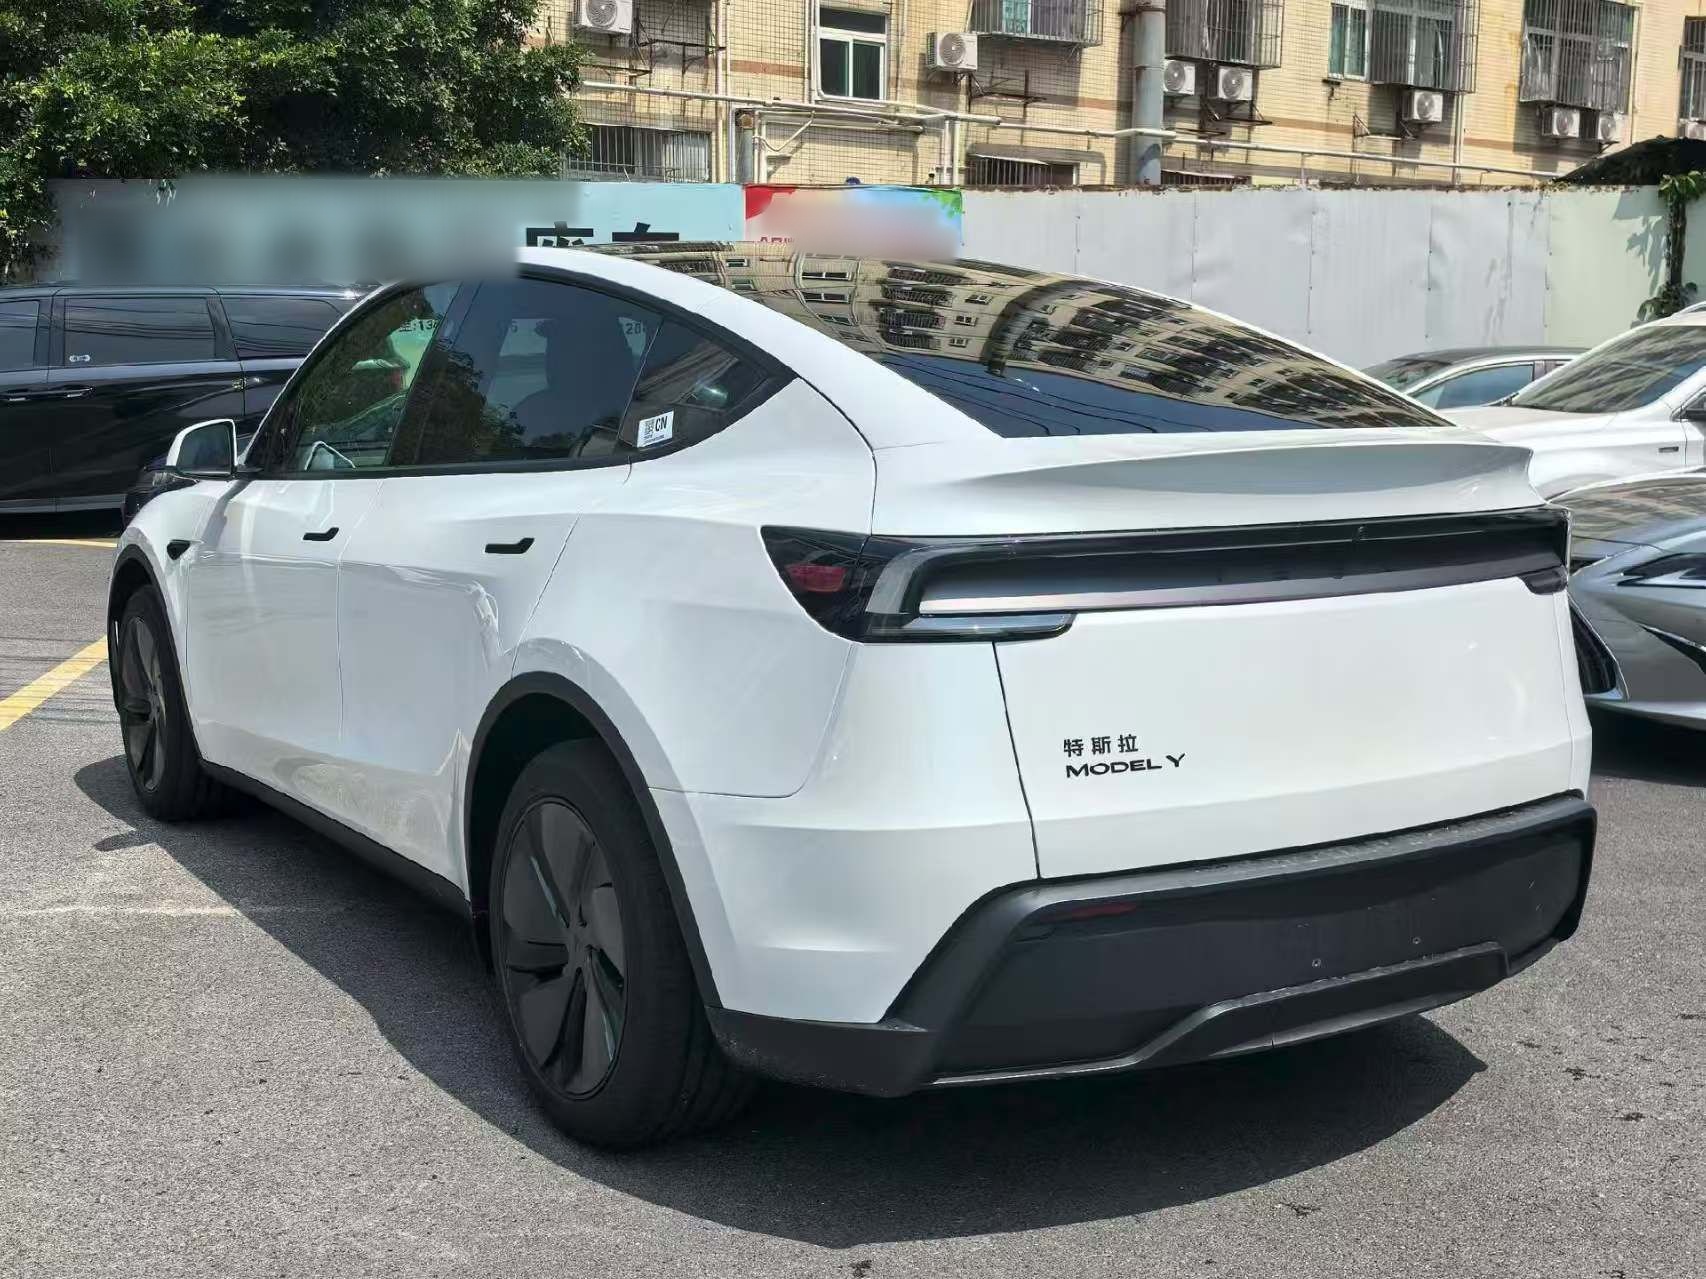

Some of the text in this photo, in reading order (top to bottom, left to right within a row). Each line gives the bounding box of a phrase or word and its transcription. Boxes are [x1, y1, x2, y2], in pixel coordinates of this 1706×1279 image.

[655, 416, 668, 432] CN
[1063, 734, 1138, 757] 特斯拉
[1066, 753, 1186, 778] MODEL Y
